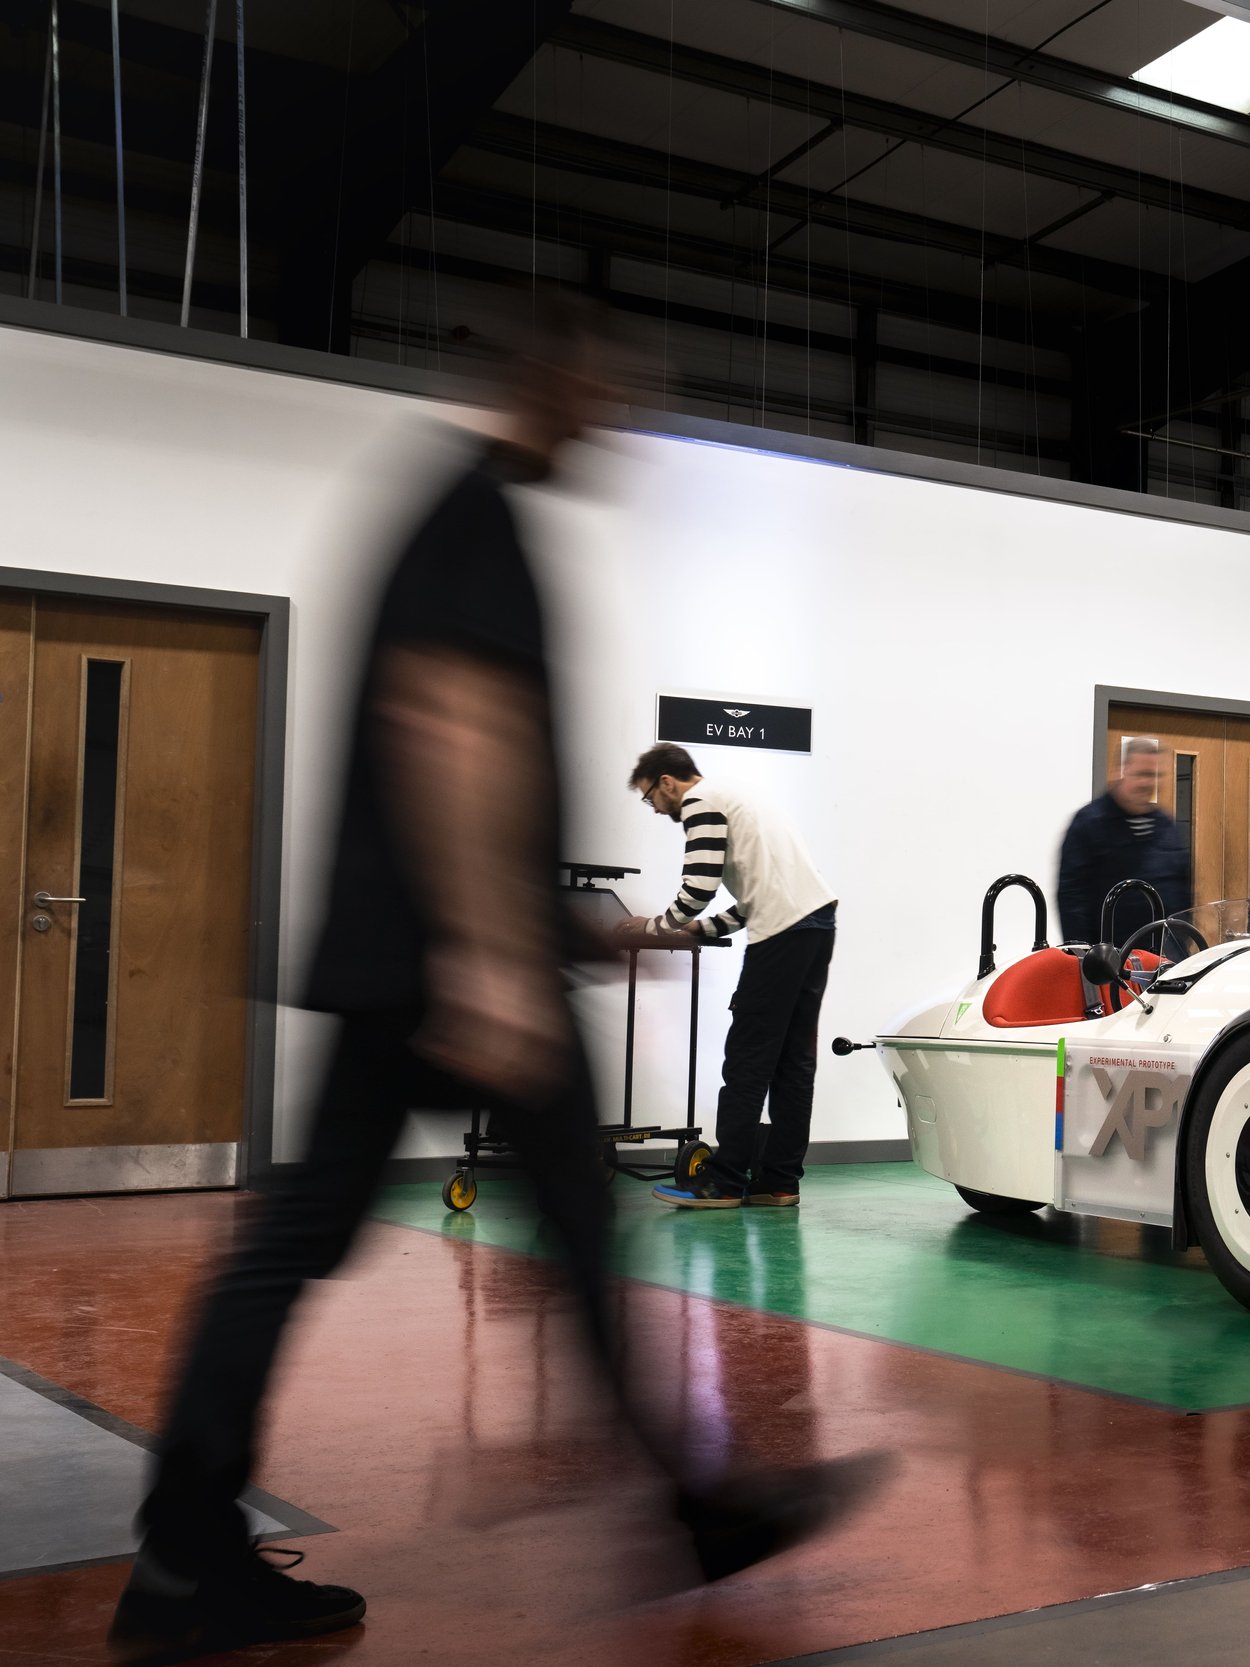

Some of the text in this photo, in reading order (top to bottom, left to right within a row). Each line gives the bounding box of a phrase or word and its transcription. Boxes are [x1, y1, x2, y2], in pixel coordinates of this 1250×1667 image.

[706, 723, 765, 740] EV BAY 1
[1089, 1056, 1176, 1070] EXPERIMENTAL PROTOTYPE
